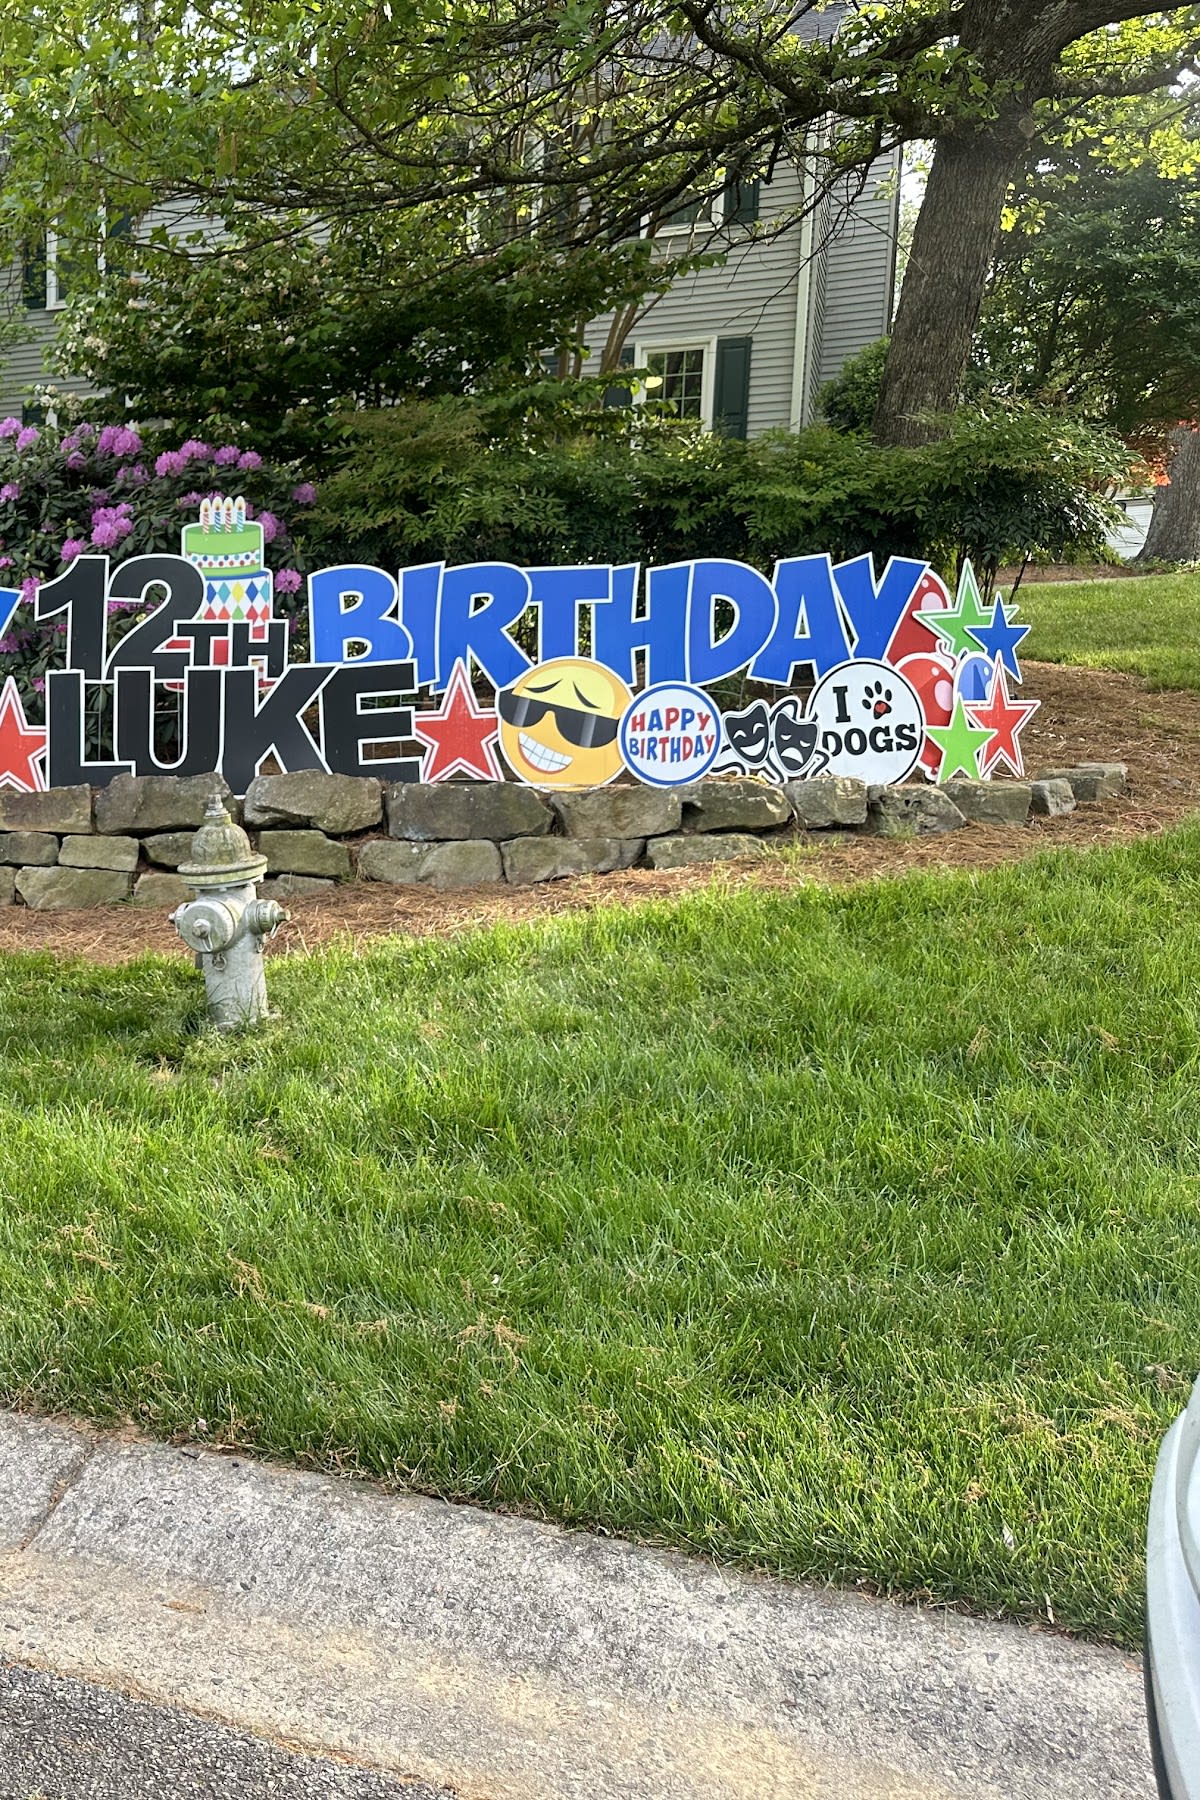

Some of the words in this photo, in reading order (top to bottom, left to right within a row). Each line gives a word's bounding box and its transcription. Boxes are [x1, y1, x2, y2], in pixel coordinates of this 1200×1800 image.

[308, 553, 929, 694] BIRTHDAY
[631, 707, 711, 732] HAPPY
[832, 685, 851, 723] I
[46, 659, 422, 798] LUKE
[822, 723, 918, 757] DOGS
[629, 735, 715, 763] BIRTHDAY
